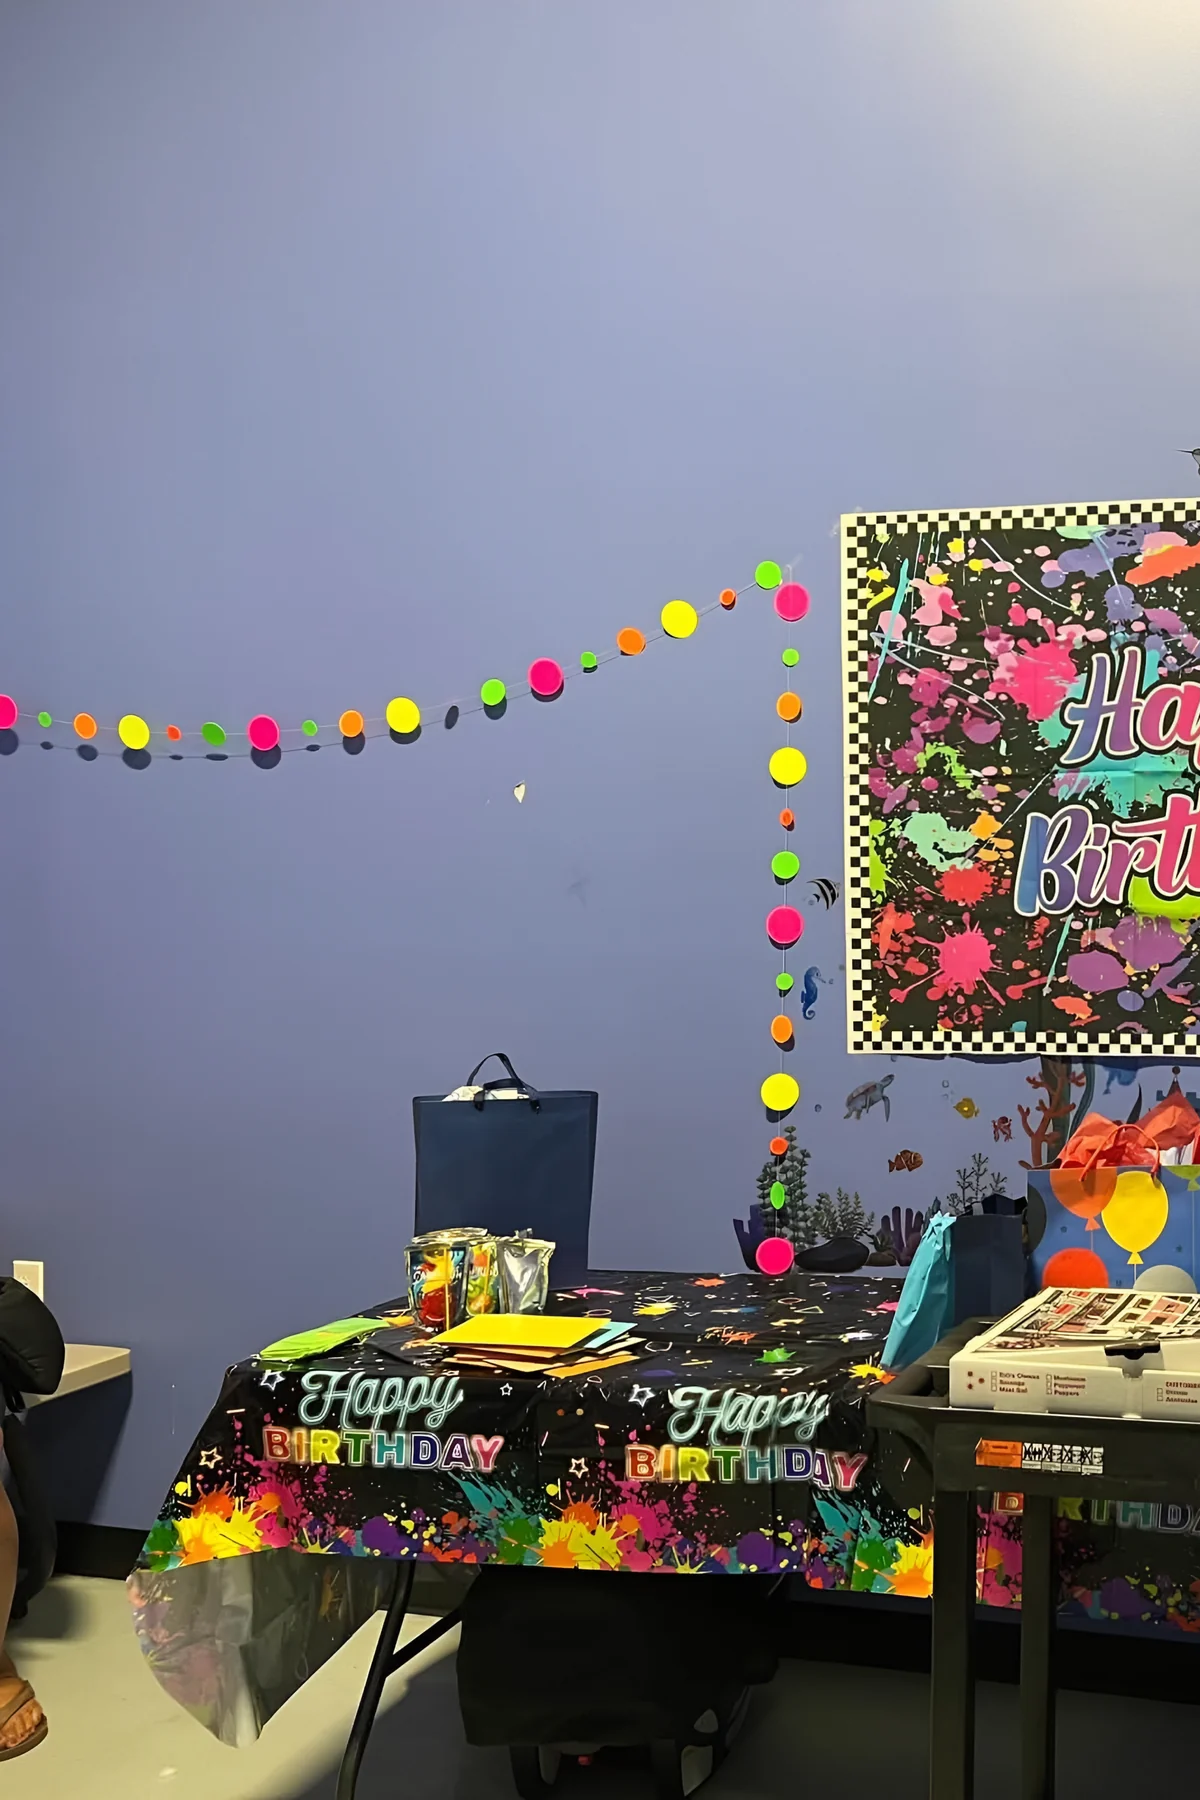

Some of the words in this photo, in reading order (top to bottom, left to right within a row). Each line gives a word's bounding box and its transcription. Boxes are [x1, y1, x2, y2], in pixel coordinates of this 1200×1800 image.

[299, 1369, 464, 1432] Happy
[667, 1385, 830, 1448] Happy
[262, 1425, 505, 1474] BIRTHDAY
[624, 1443, 868, 1492] BIRTHDAY
